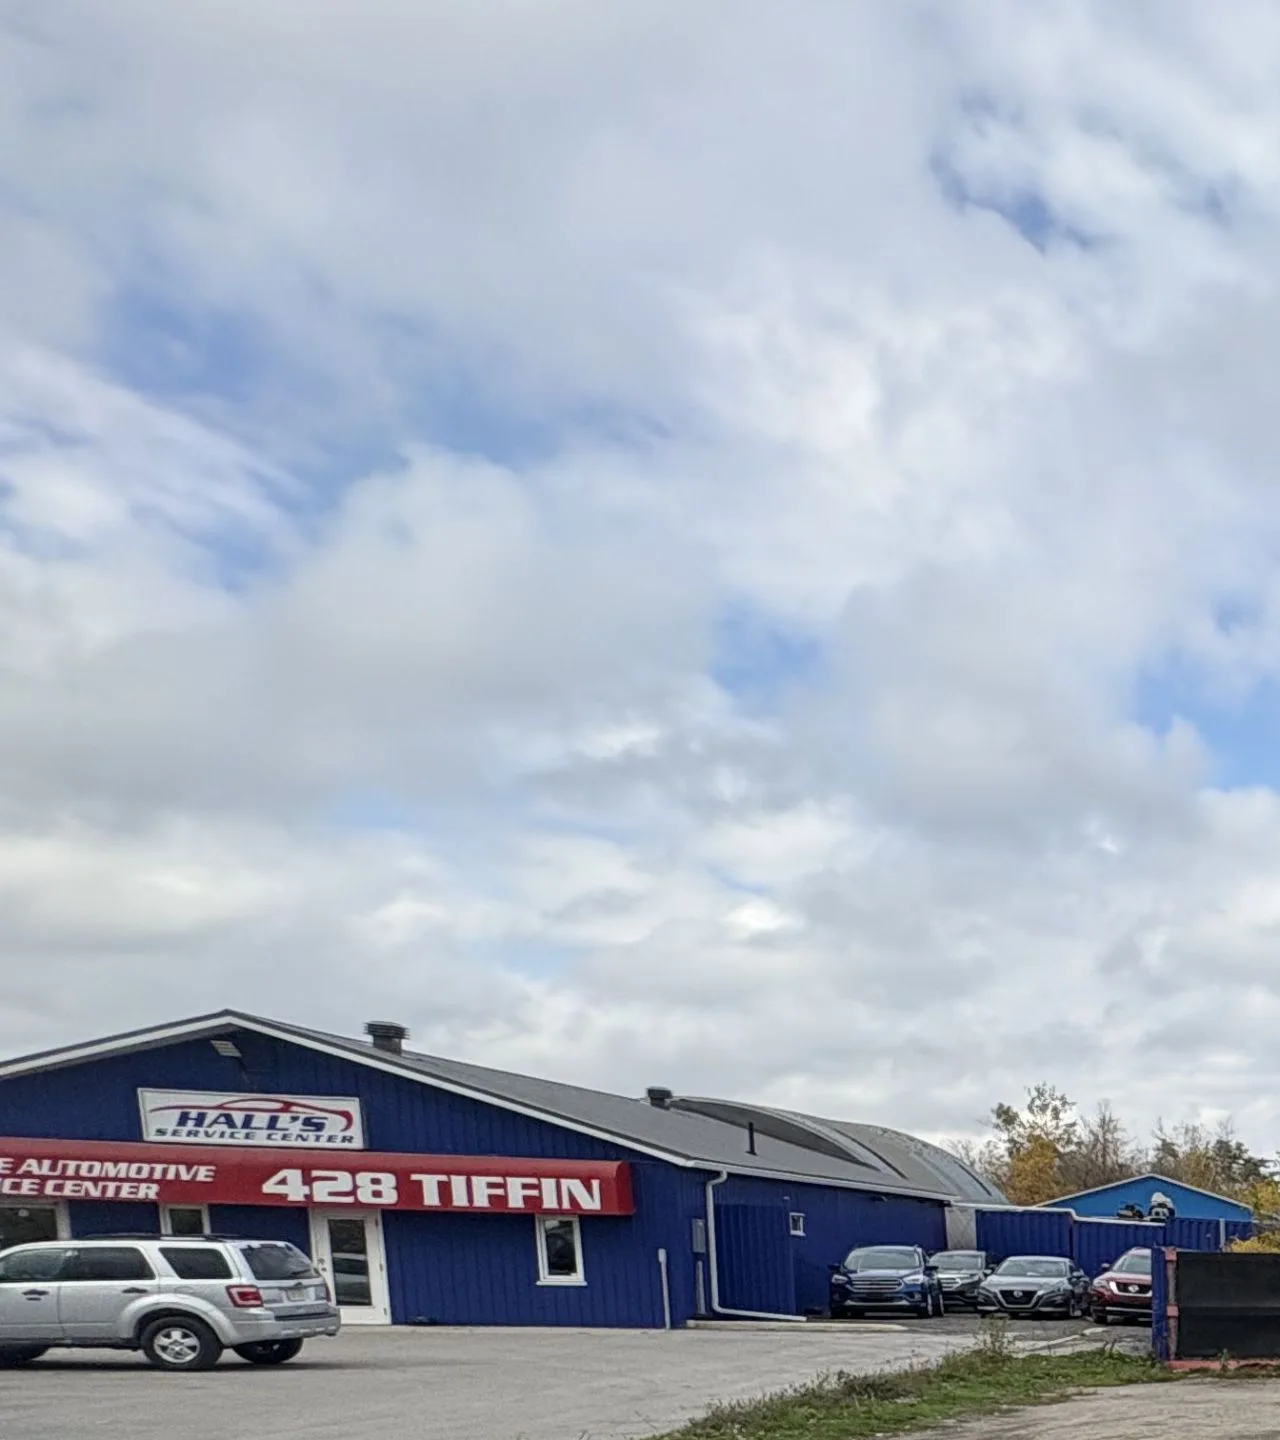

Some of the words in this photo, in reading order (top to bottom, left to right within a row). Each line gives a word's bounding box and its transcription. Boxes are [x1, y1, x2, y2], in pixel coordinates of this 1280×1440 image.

[175, 1111, 329, 1133] HALL'S
[154, 1128, 257, 1141] SERVICE
[265, 1134, 354, 1144] CENTER
[16, 1158, 217, 1183] AUTOMOTIVE
[0, 1177, 41, 1195] CE
[44, 1179, 160, 1200] CENTER
[262, 1168, 398, 1204] 428
[410, 1174, 601, 1210] TIFFIN
